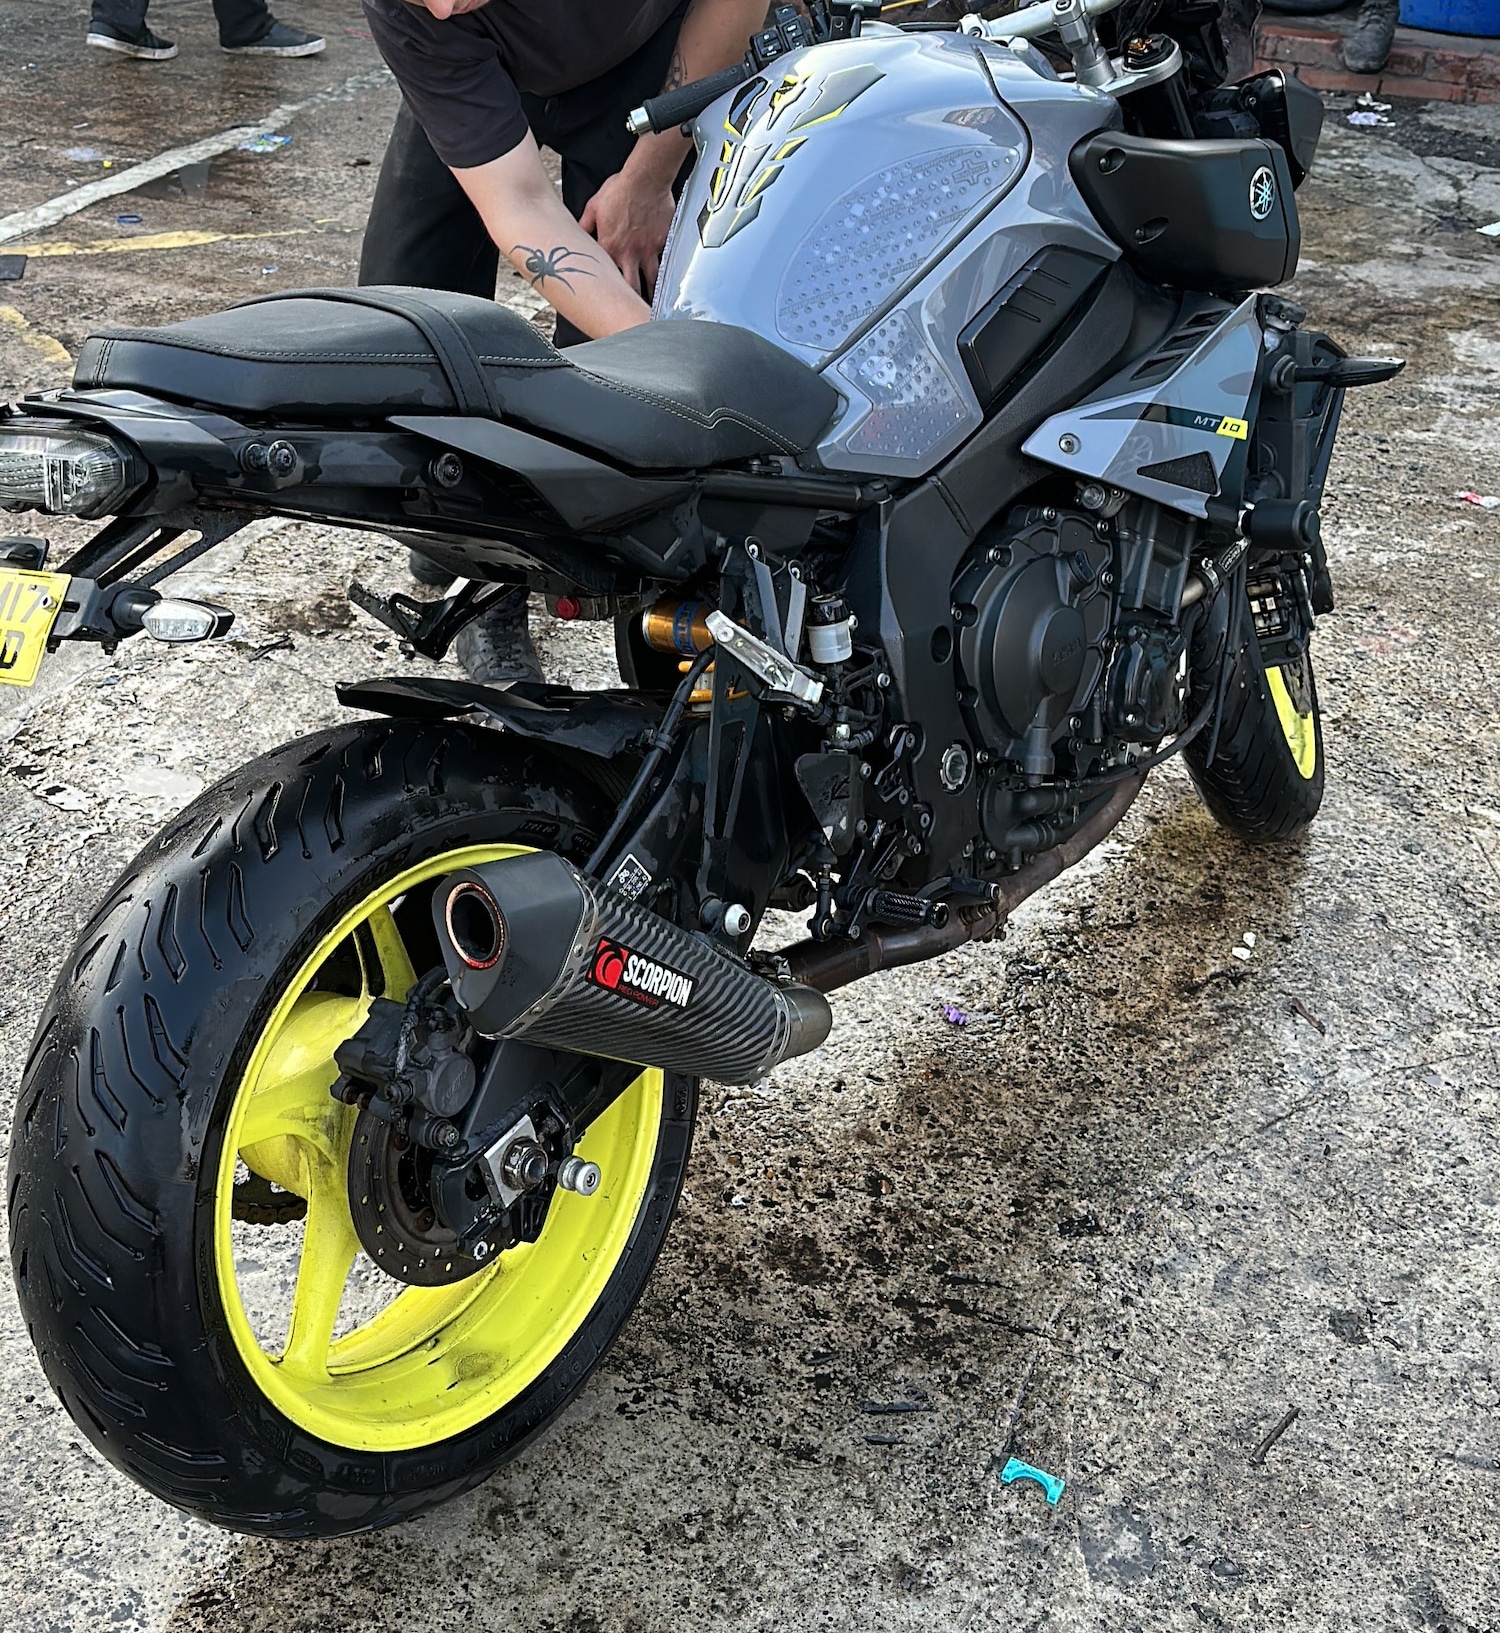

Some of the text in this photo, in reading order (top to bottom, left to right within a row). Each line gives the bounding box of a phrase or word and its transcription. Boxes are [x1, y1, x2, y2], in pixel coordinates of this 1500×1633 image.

[1193, 415, 1240, 432] MT 10
[0, 629, 25, 669] D
[618, 985, 659, 1006] RED POWER
[623, 954, 693, 1007] SCORPION
